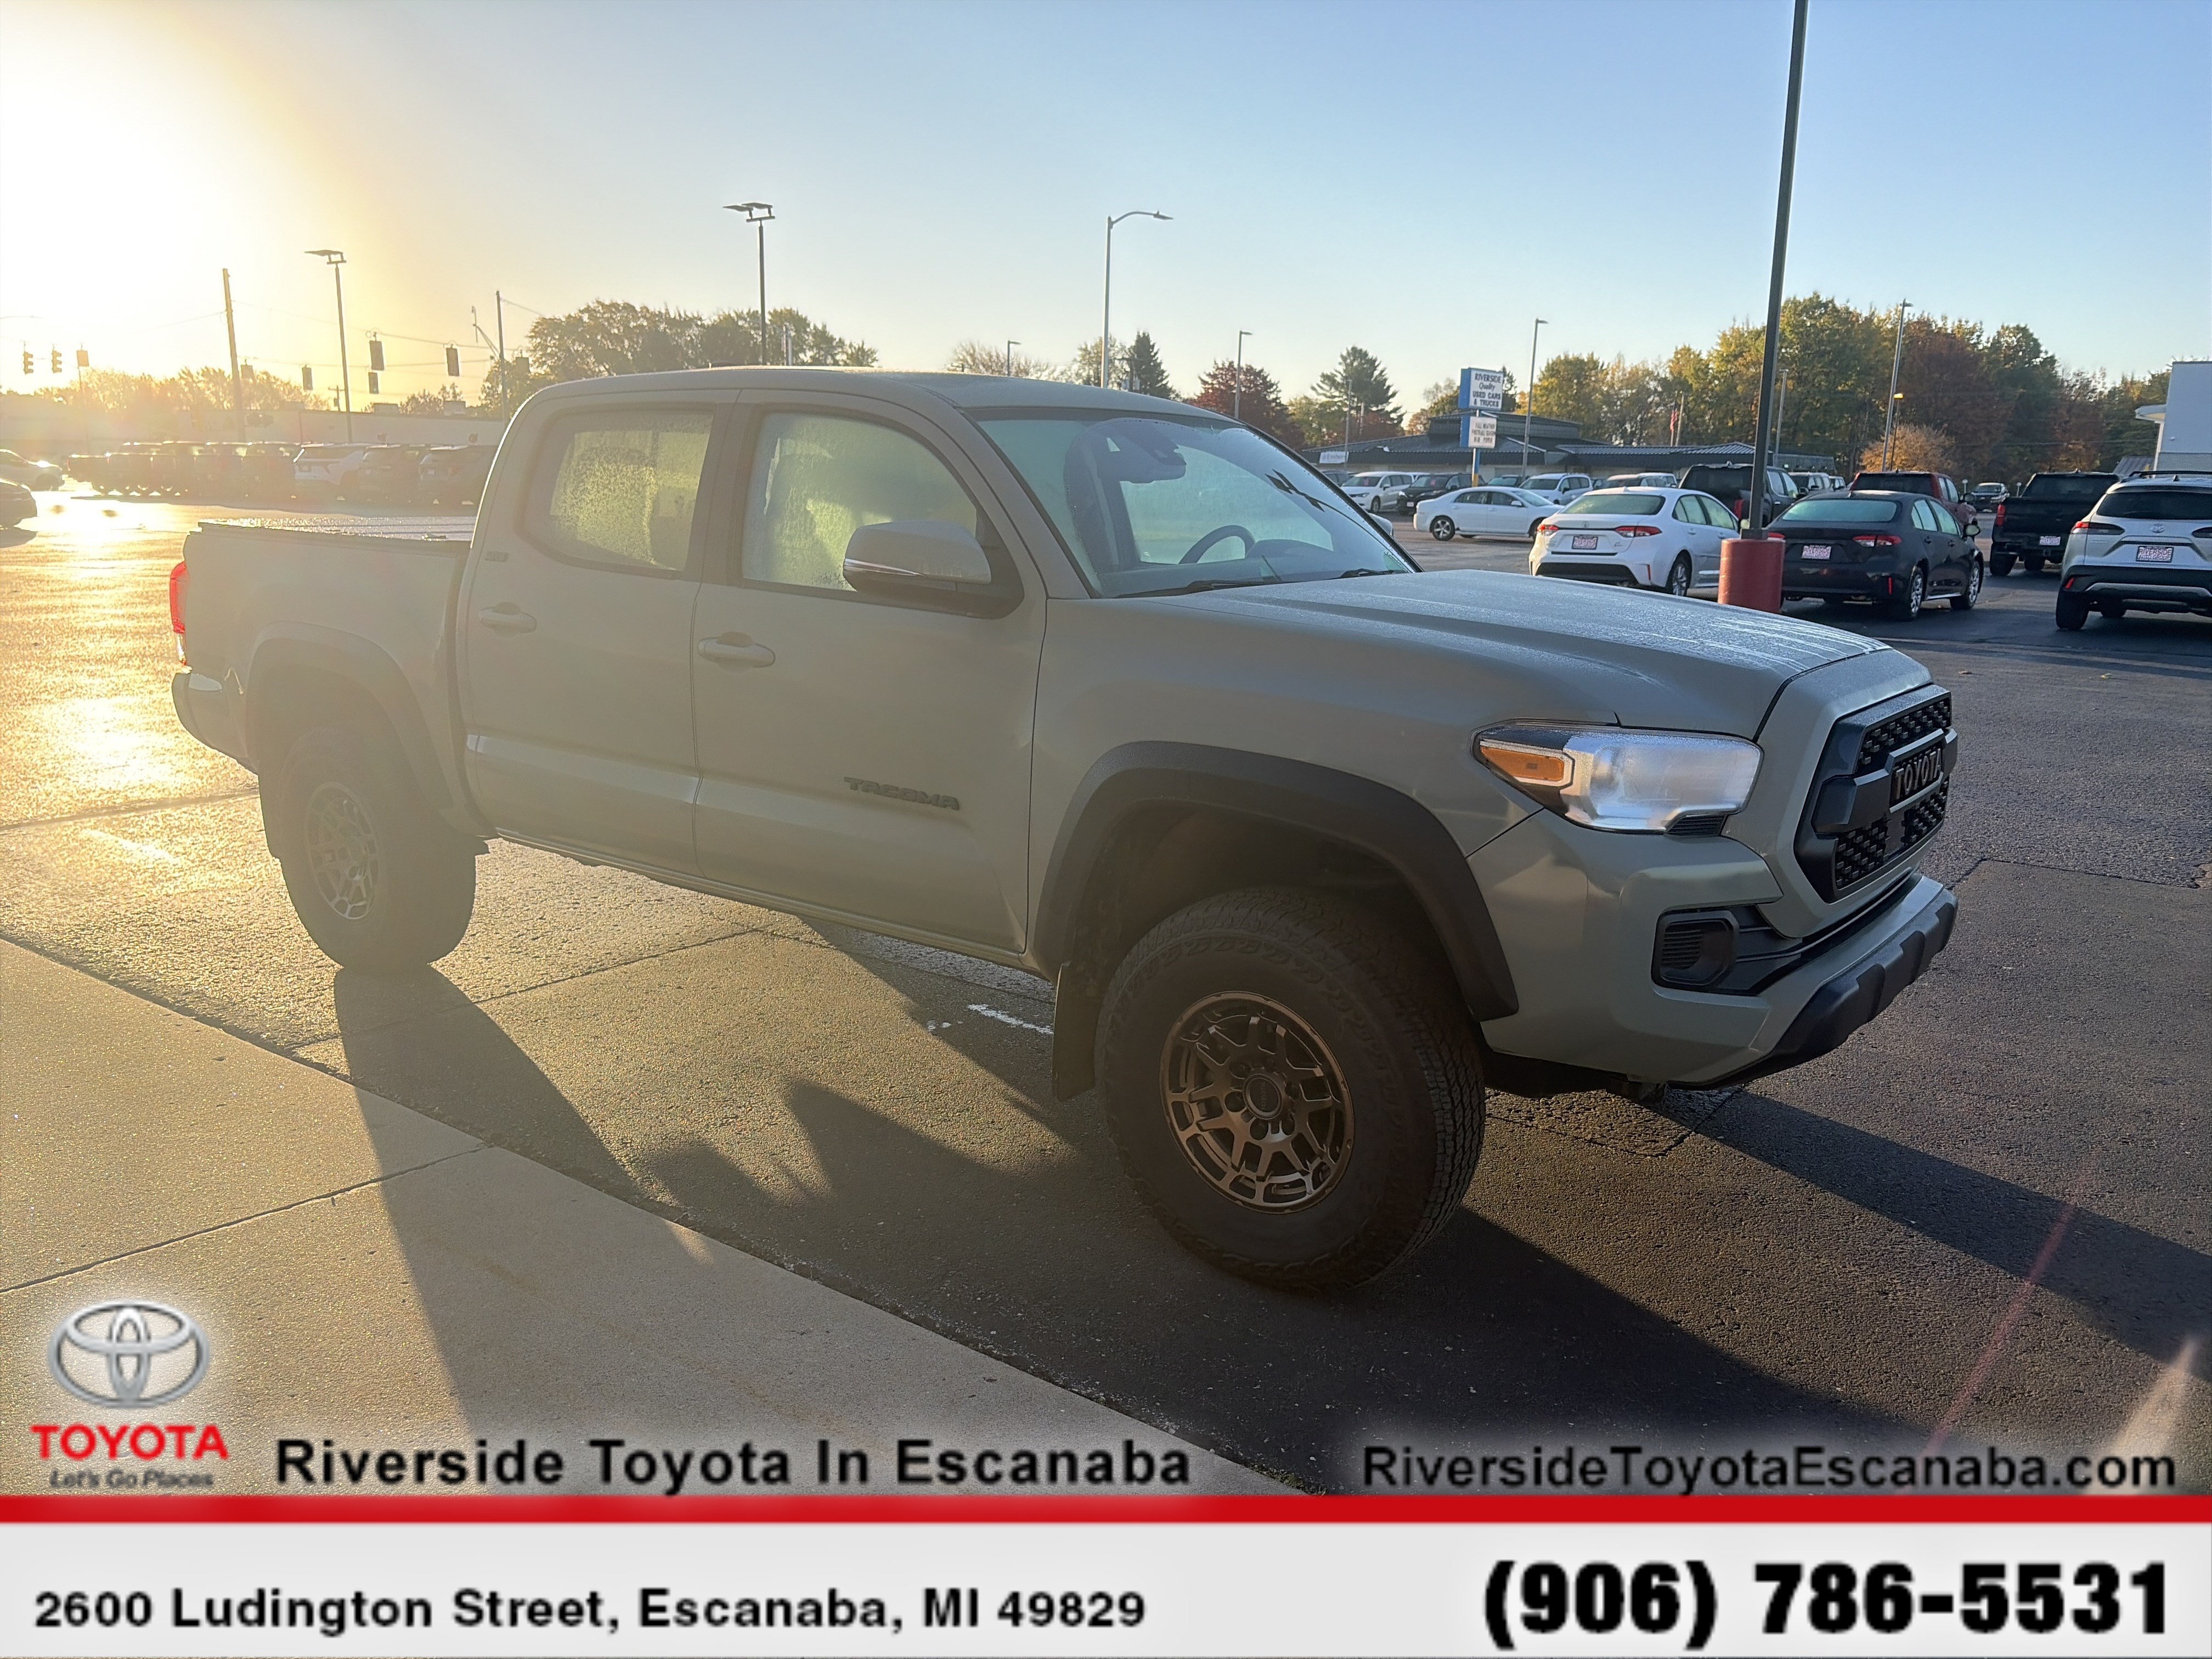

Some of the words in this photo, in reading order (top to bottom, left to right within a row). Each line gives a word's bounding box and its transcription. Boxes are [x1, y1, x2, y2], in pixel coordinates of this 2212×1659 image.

[1475, 373, 1501, 383] RIVERSIDE
[1479, 382, 1495, 391] Quality
[1895, 748, 1942, 800] TOYOTA
[843, 776, 960, 810] TACOMA
